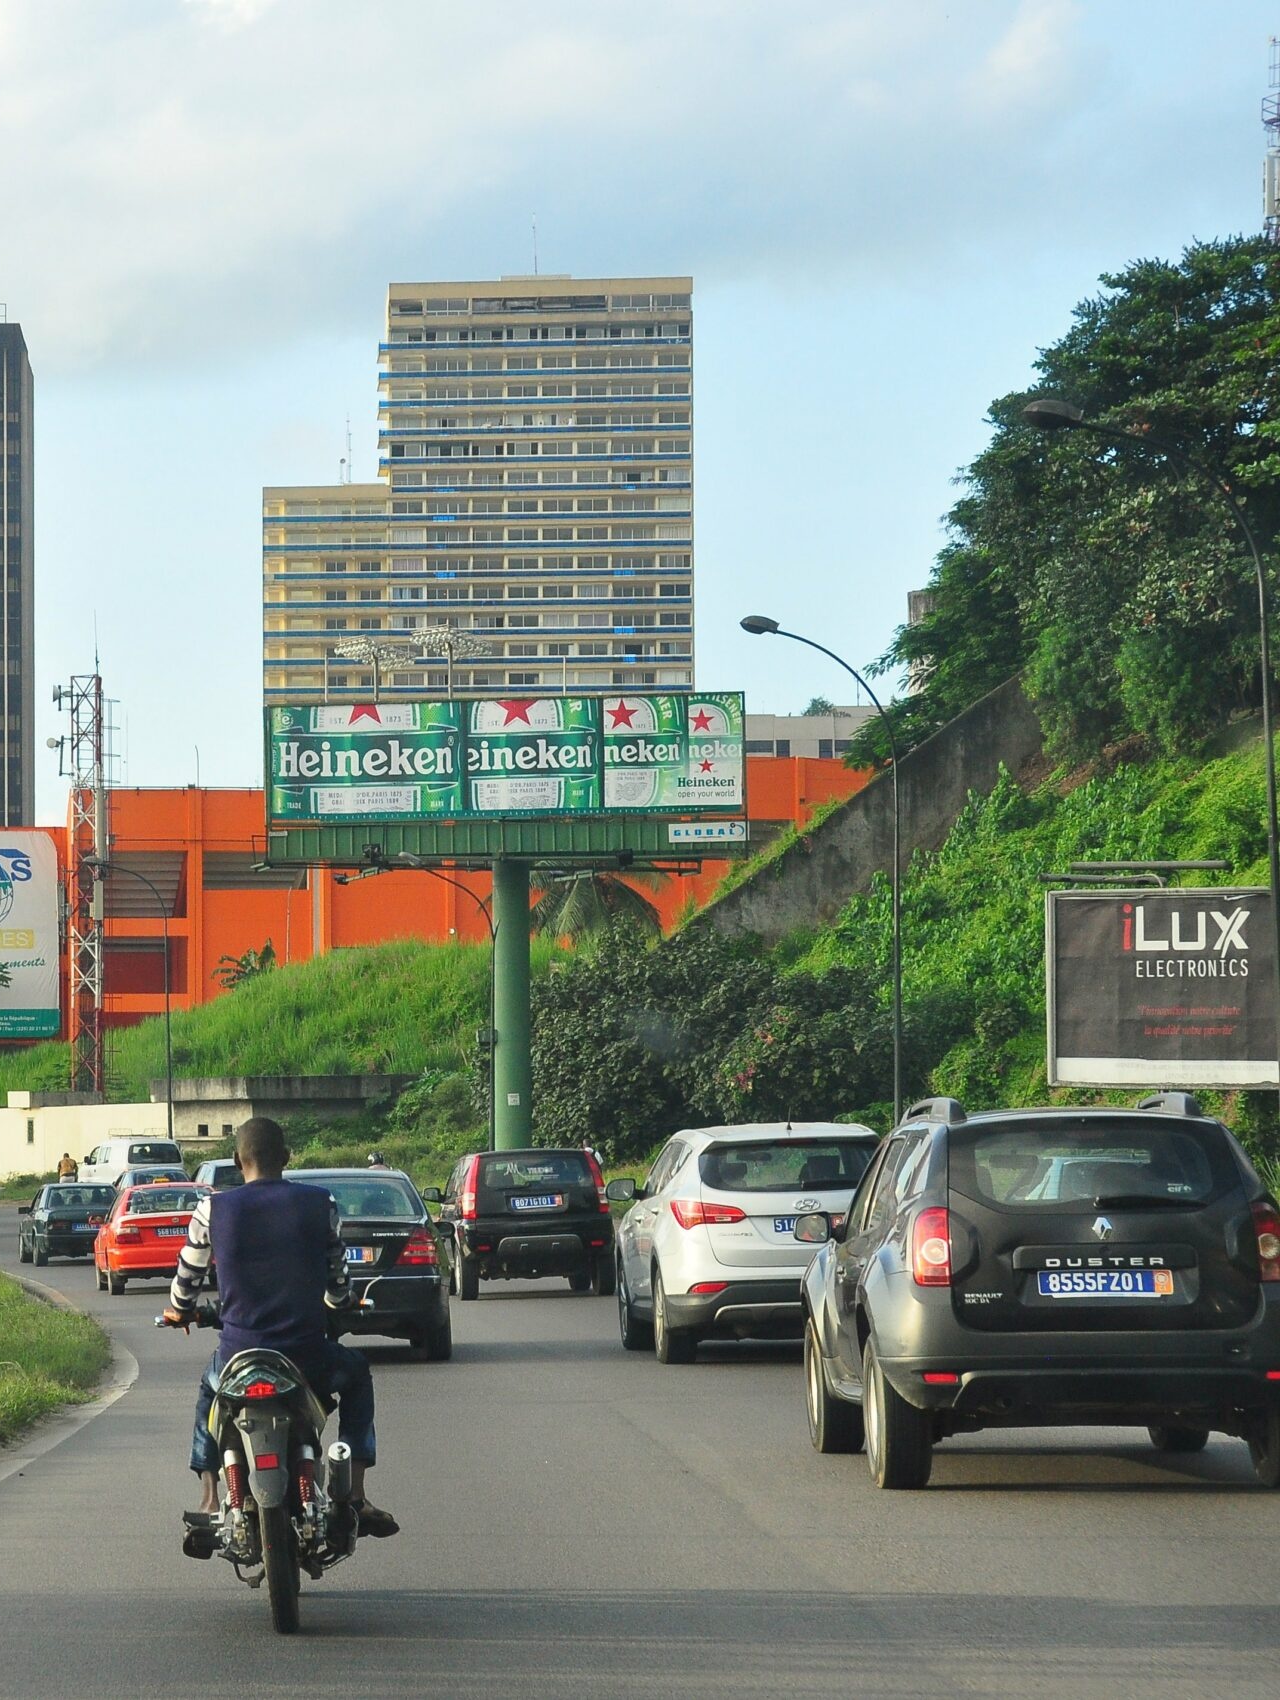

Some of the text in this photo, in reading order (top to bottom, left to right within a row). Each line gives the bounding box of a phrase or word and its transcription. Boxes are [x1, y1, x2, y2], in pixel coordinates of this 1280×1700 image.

[278, 740, 453, 777] Heineken
[468, 739, 592, 771] eineken
[604, 740, 680, 763] neken
[677, 776, 735, 787] Heineken
[697, 790, 714, 798] your
[714, 789, 735, 797] world
[286, 801, 302, 810] TRADE
[673, 828, 735, 837] GLOBAL
[1135, 958, 1249, 978] ELECTRONICS
[1045, 1257, 1165, 1267] DUSTER
[1048, 1272, 1144, 1292] 8555FZ01
